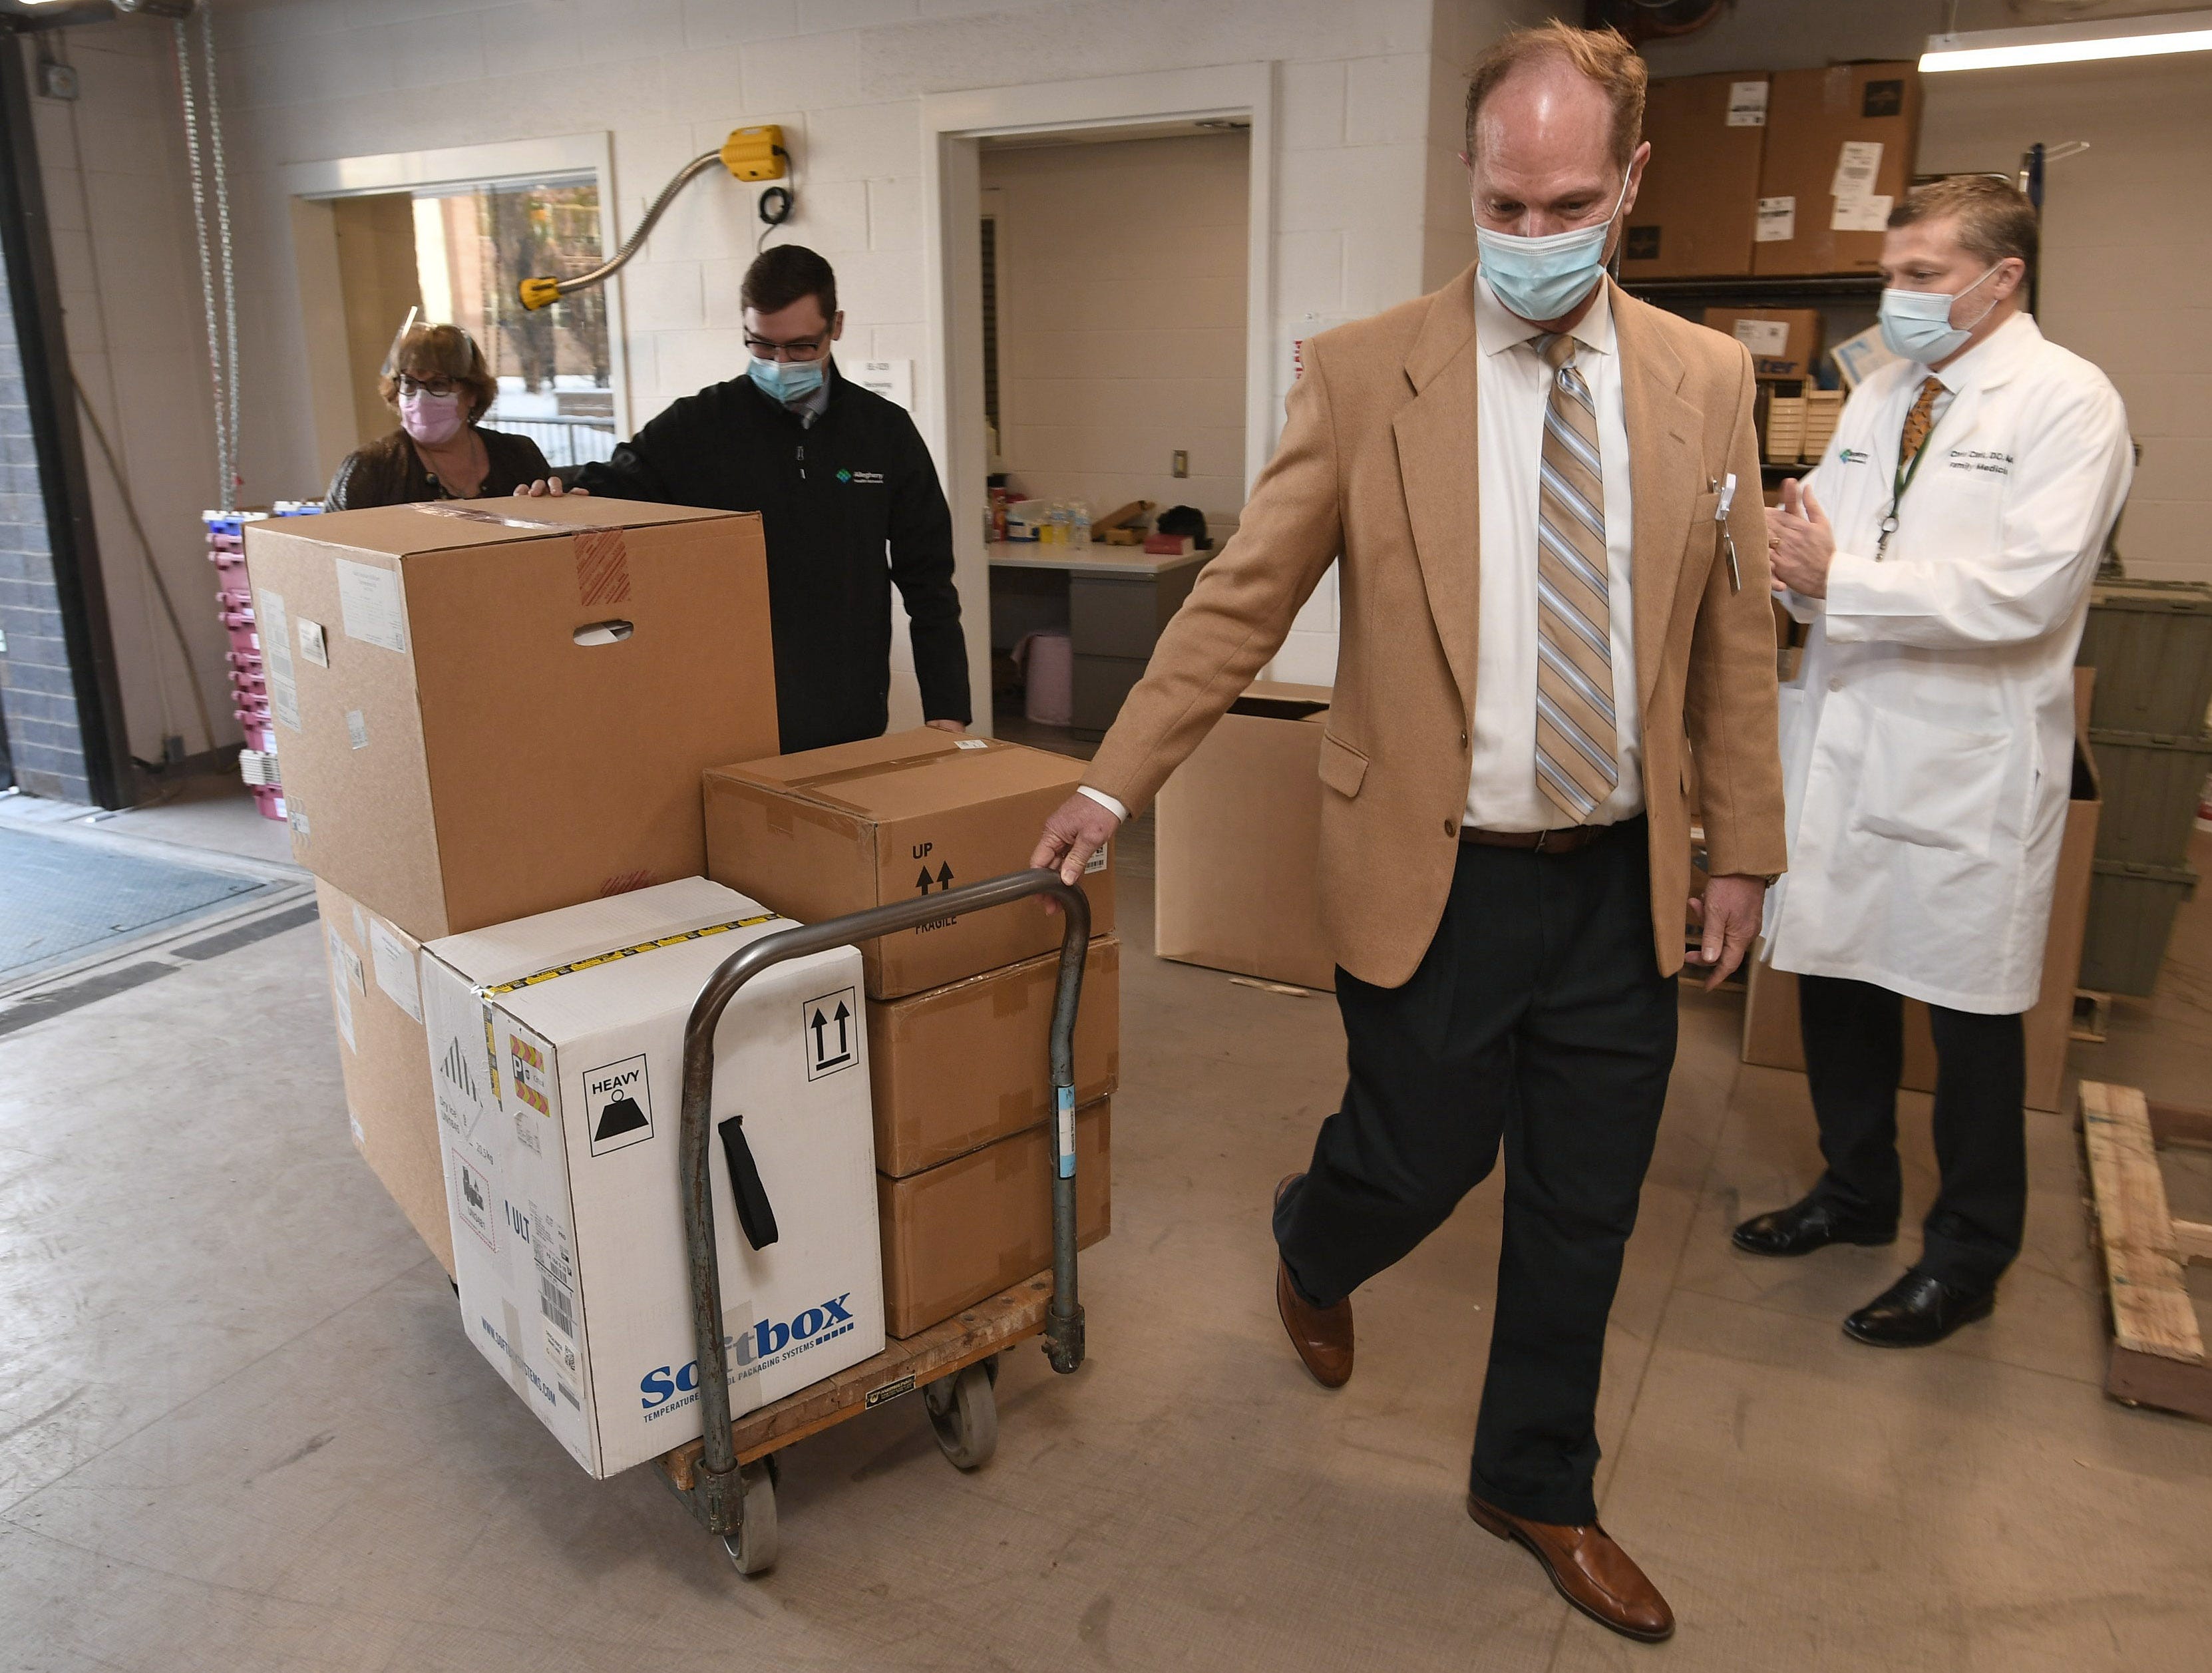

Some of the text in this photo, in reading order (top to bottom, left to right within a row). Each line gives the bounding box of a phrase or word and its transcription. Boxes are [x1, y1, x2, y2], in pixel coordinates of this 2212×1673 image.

[913, 842, 933, 859] UP
[592, 1069, 640, 1095] HEAVY
[512, 1207, 530, 1244] ULT
[644, 1340, 815, 1423] TEMPERATURE PACKAGING SYSTEMS
